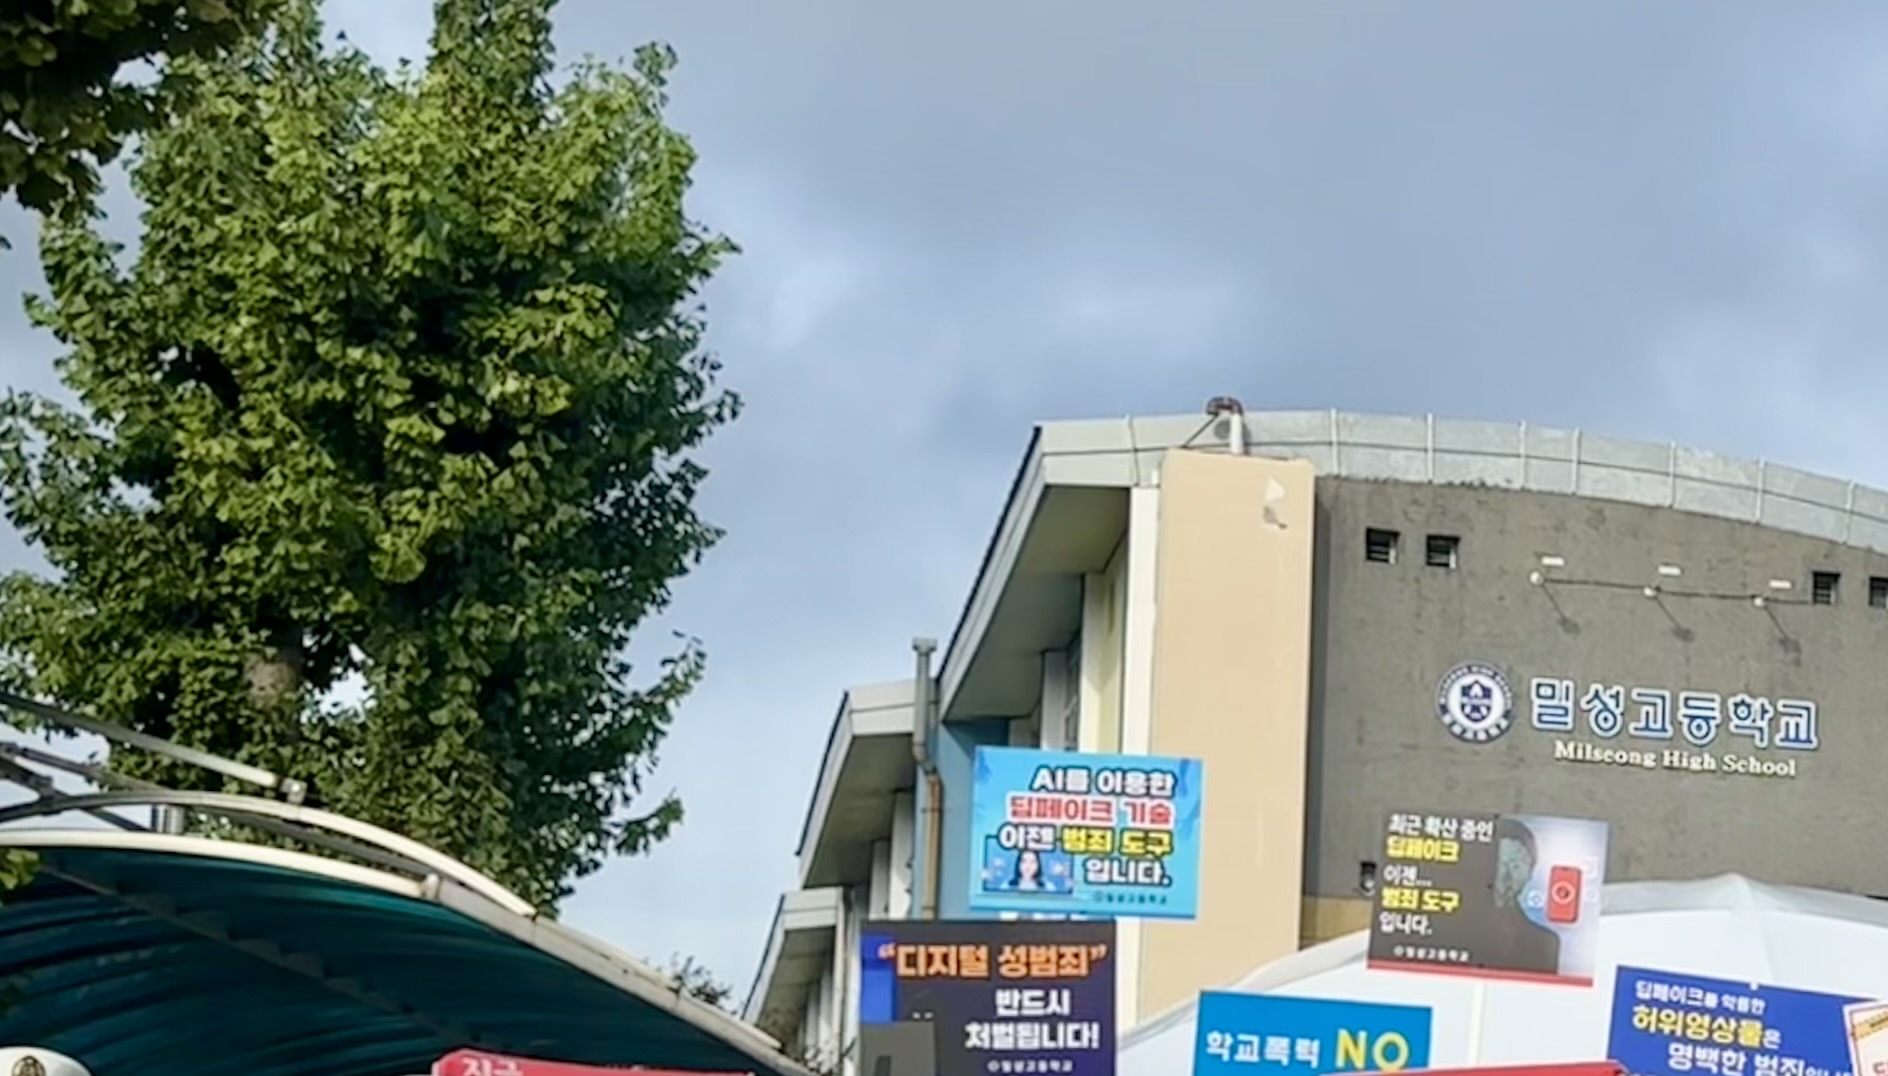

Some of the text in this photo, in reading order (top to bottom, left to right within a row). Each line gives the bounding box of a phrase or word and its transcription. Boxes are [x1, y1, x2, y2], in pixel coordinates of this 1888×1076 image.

[1531, 677, 1819, 750] 밀성고등학교
[1554, 739, 1797, 777] Milseong High School
[1030, 766, 1176, 798] AI를 이용한
[1009, 795, 1173, 826] 딥페이크 기술
[1388, 813, 1422, 836] 최근
[999, 825, 1173, 858] 이젠 범죄 도구
[1386, 836, 1461, 862] 딥페이크
[1085, 858, 1172, 886] 입니다.
[1381, 887, 1461, 914] 범죄 도구
[1379, 911, 1433, 936] 입니다.
[994, 988, 1072, 1018] 반드시
[964, 1022, 1101, 1051] 처벌됩니다!
[1632, 1004, 1782, 1050] 허위영상물은
[1206, 1028, 1410, 1072] 학교폭력 NO
